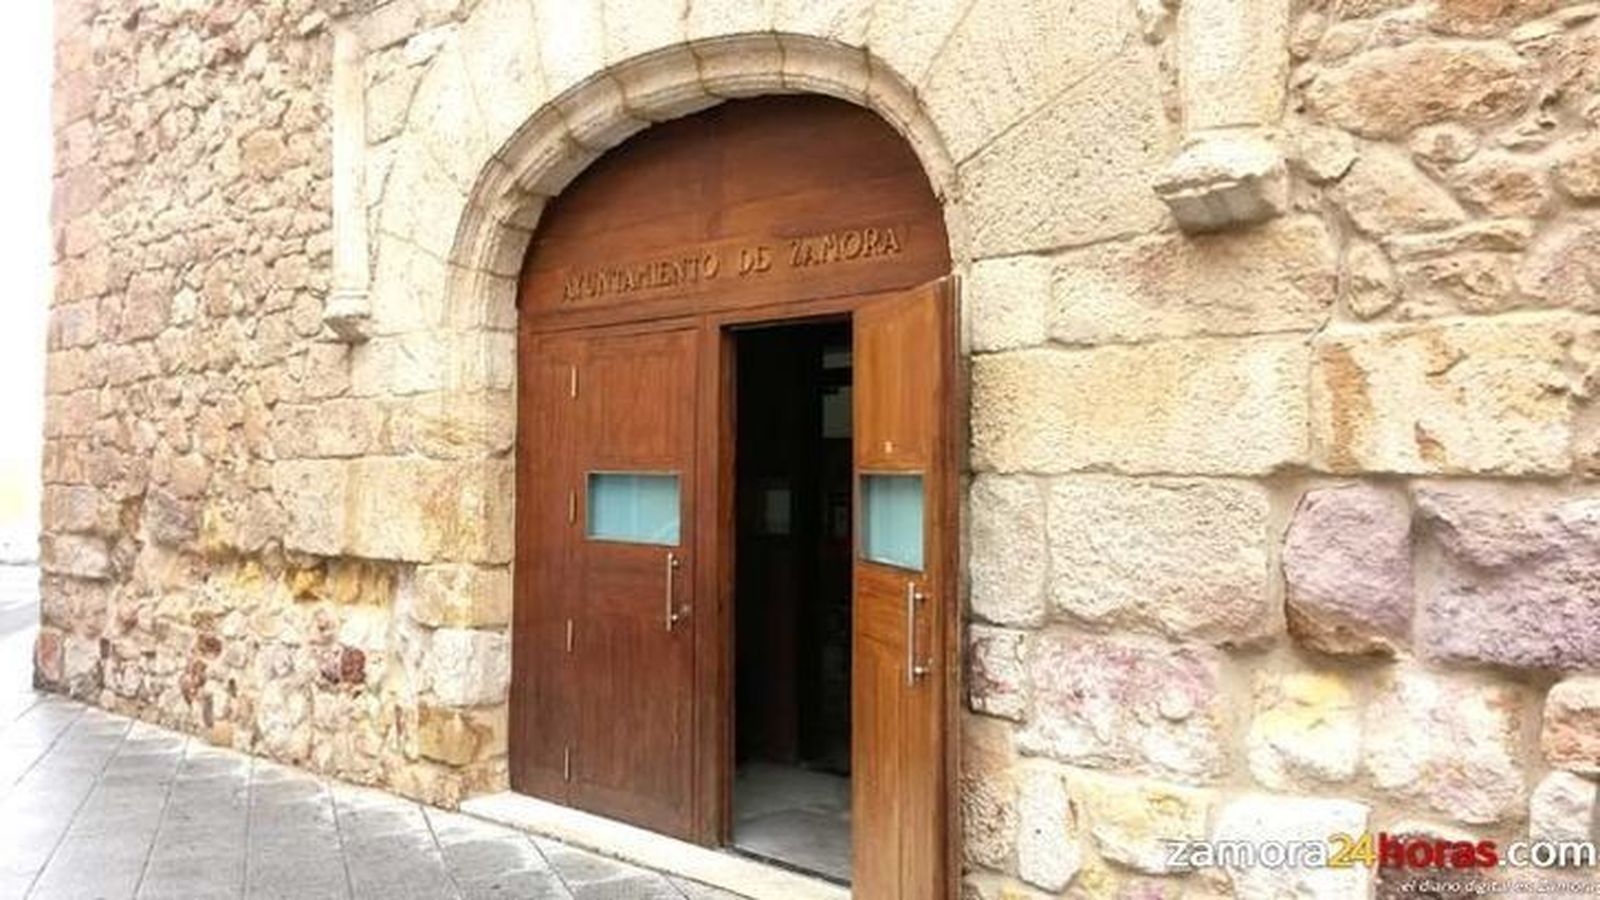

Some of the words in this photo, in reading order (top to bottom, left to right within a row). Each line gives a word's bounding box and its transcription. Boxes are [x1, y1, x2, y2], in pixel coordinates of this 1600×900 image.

[561, 251, 721, 301] AYUNTAMIENTO
[739, 244, 772, 277] DE
[789, 227, 903, 267] ZAMORA
